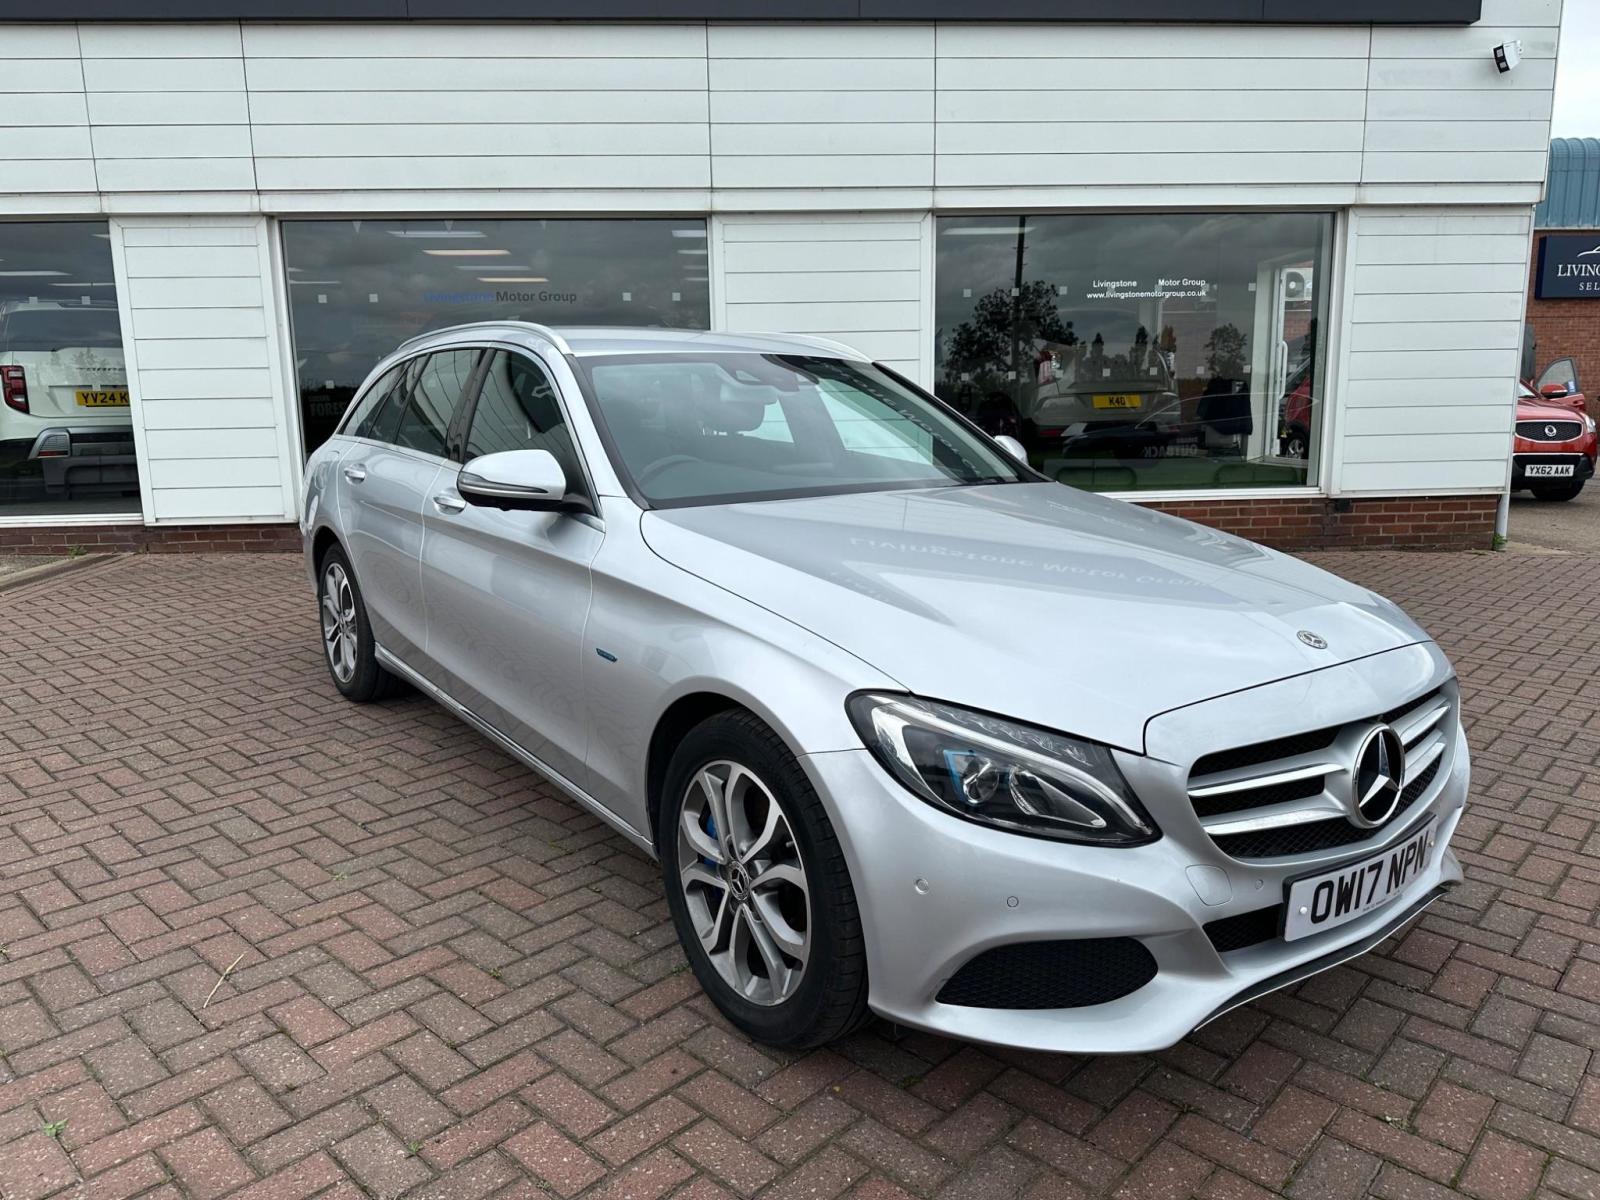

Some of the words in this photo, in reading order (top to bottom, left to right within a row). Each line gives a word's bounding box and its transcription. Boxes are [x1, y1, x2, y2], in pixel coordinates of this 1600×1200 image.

[1093, 280, 1137, 289] Livingstone
[1158, 279, 1180, 287] Motor
[1182, 278, 1206, 287] Group
[496, 291, 535, 302] Motor
[538, 291, 577, 304] Group
[1087, 290, 1206, 300] www.livingstonemotorgroup.co.uk
[81, 392, 116, 404] YV24
[1530, 465, 1553, 475] YX62
[1554, 465, 1570, 475] AAK
[1310, 859, 1384, 925] OW17
[1385, 830, 1429, 895] NPN
